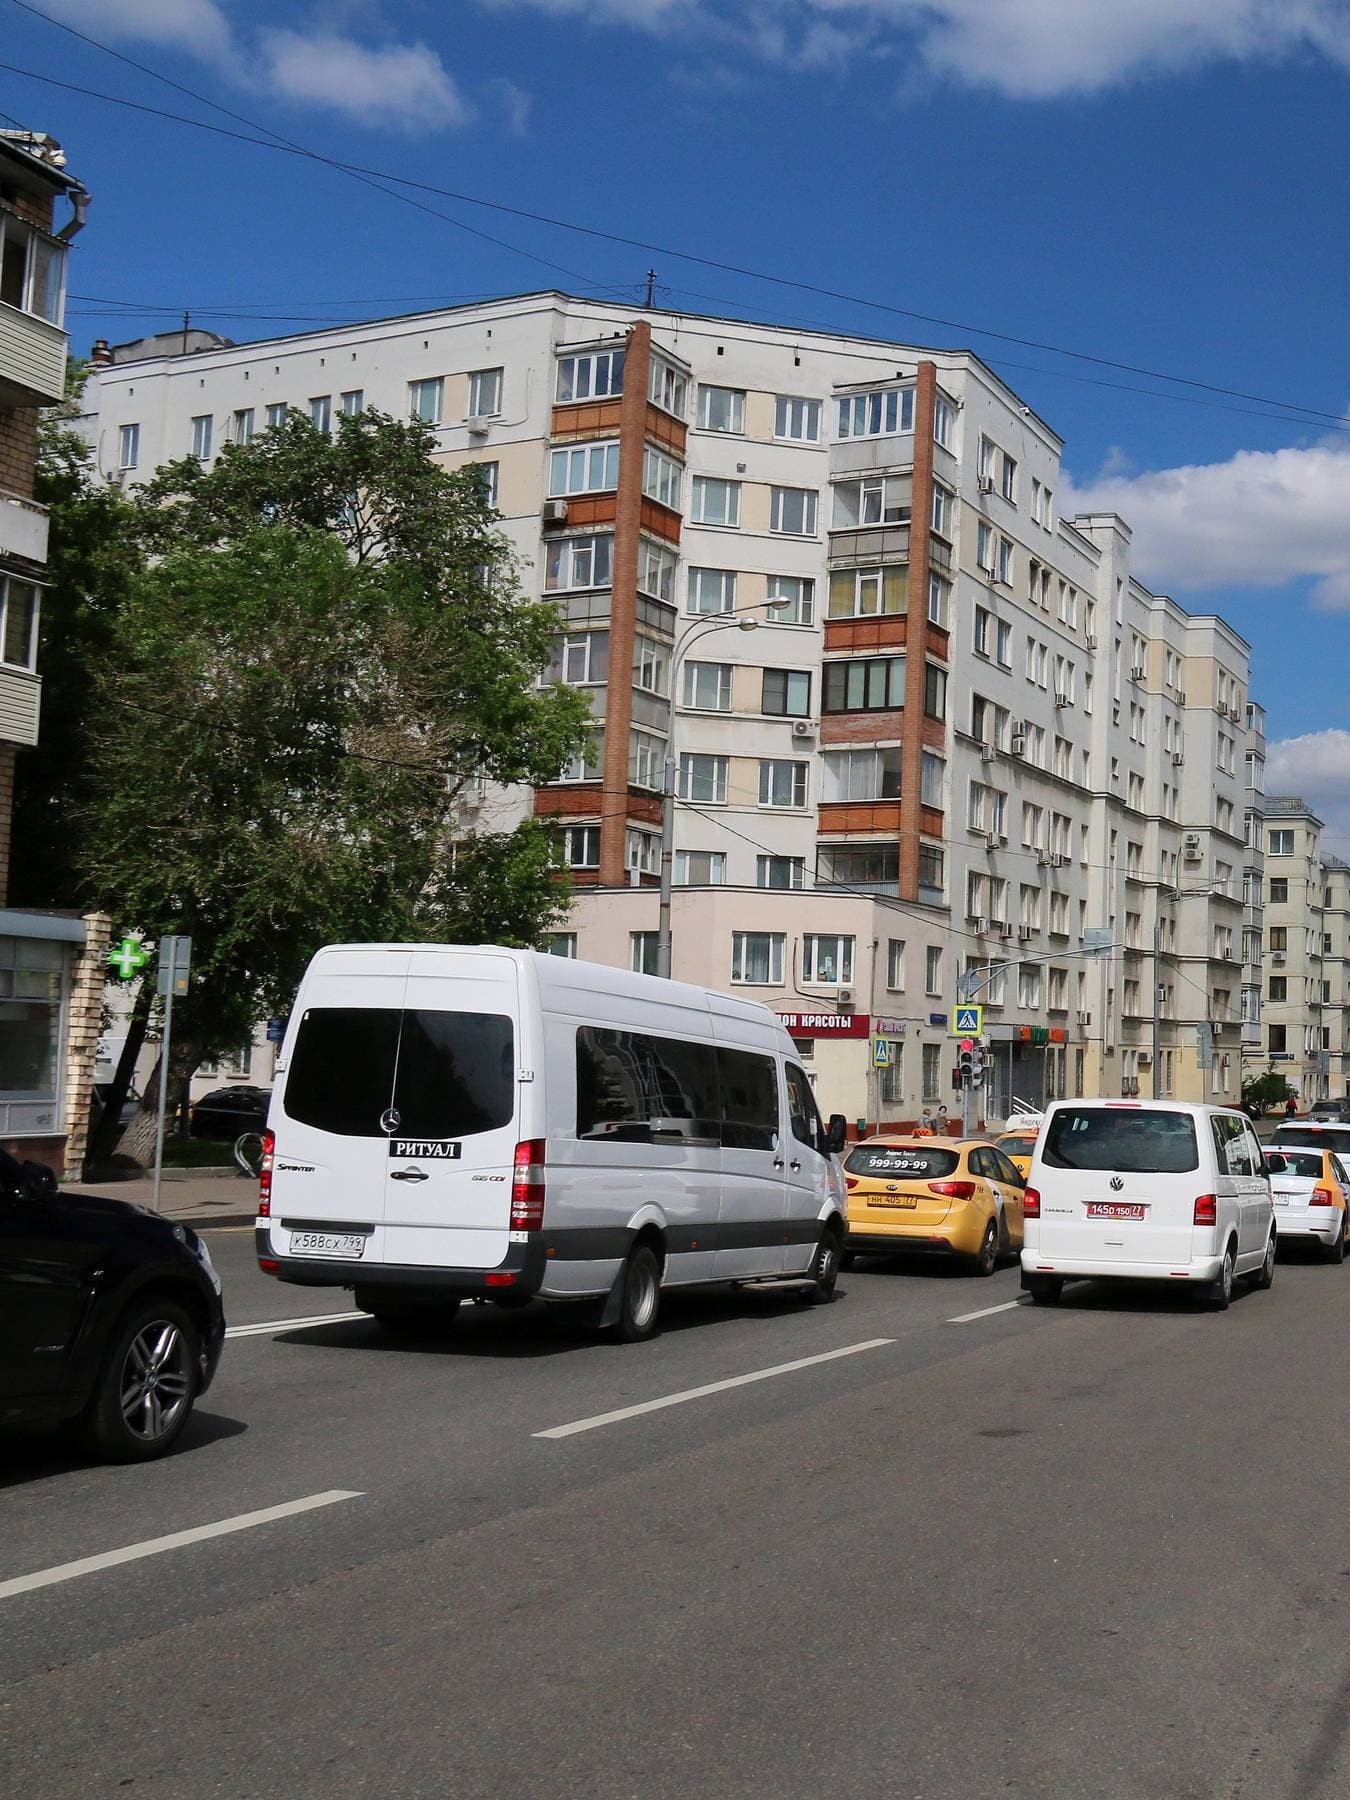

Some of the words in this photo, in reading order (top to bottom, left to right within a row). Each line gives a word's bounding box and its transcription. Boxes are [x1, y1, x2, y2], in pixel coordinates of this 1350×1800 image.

[802, 1015, 852, 1028] КРАСОТЫ
[396, 1142, 455, 1158] РИТУАЛ
[869, 1158, 928, 1170] 999-99-99
